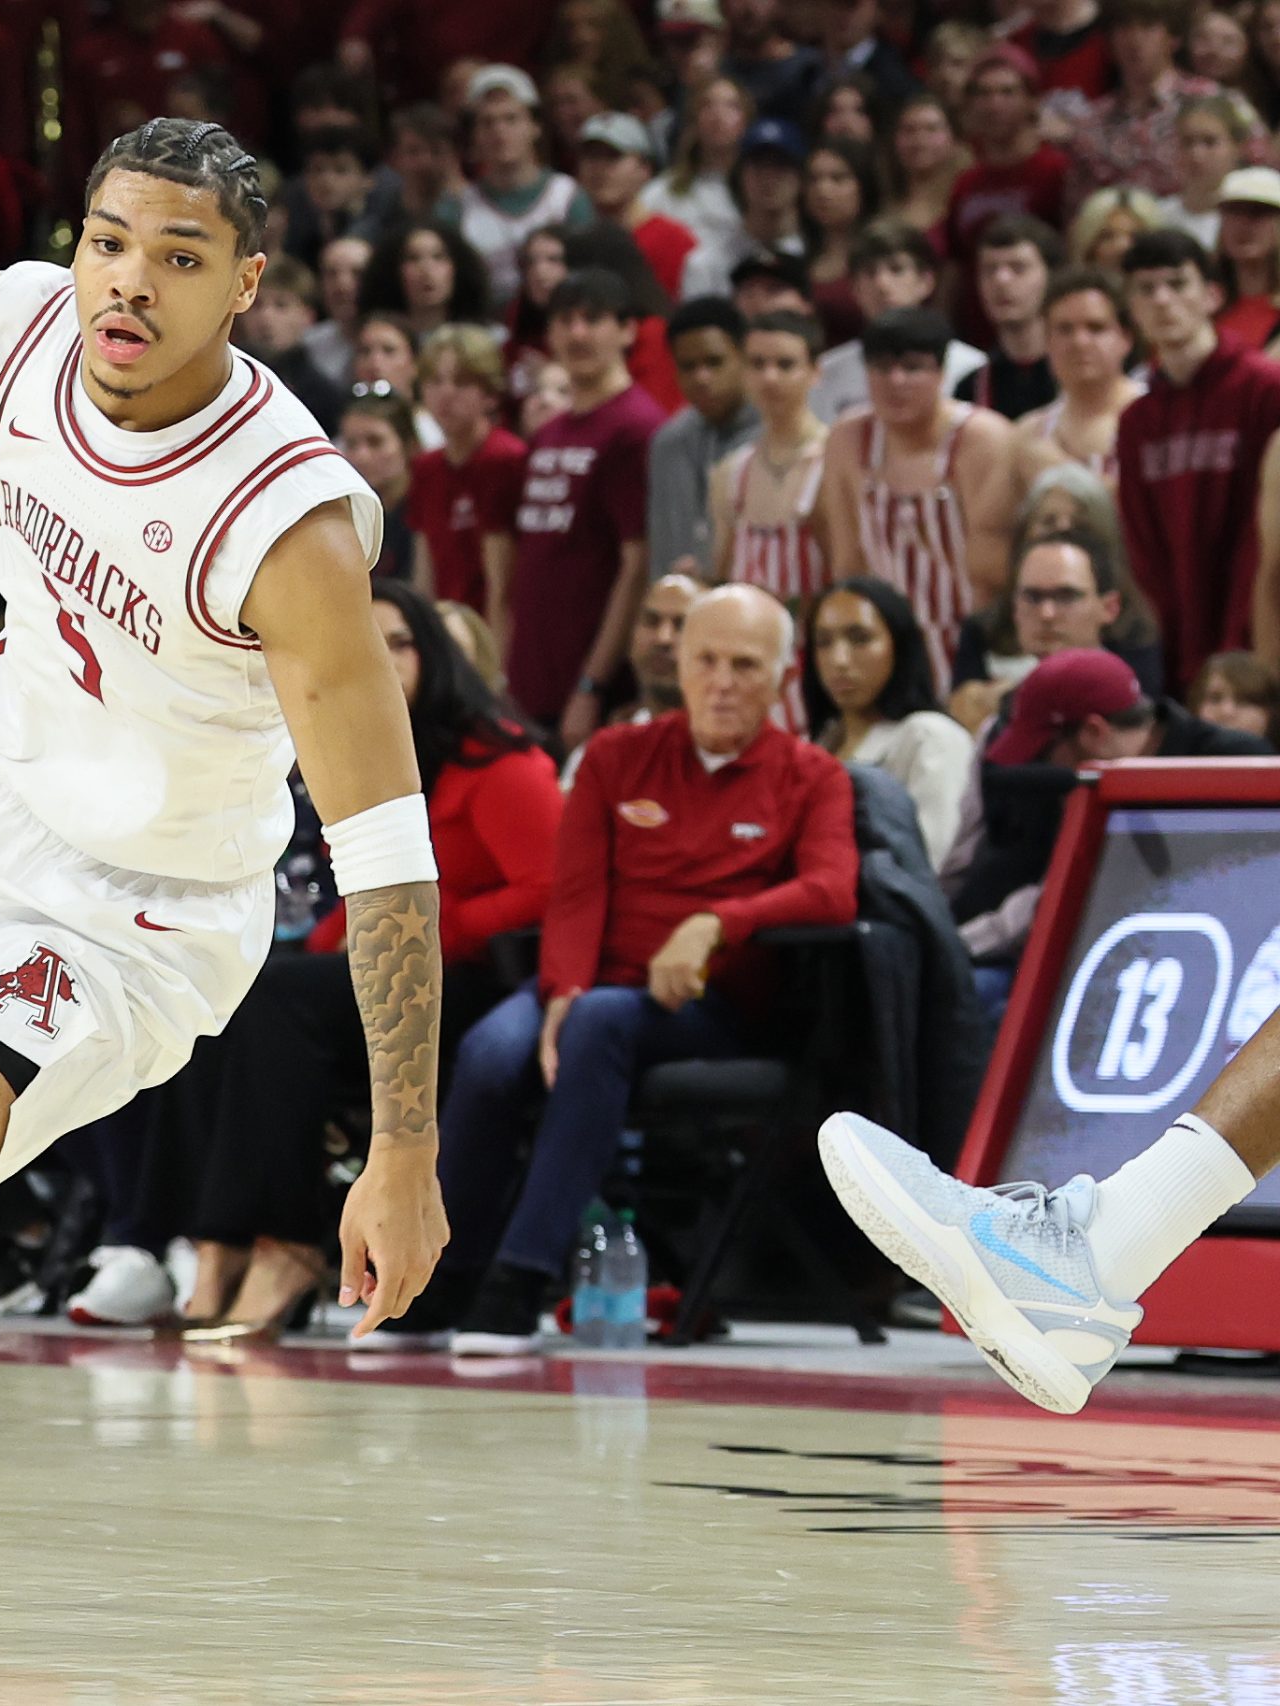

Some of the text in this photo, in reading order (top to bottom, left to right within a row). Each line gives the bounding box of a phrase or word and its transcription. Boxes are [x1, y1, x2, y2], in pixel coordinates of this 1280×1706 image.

[0, 479, 164, 656] RAZORBACKS
[143, 520, 173, 553] SEC
[1096, 957, 1184, 1081] 13
